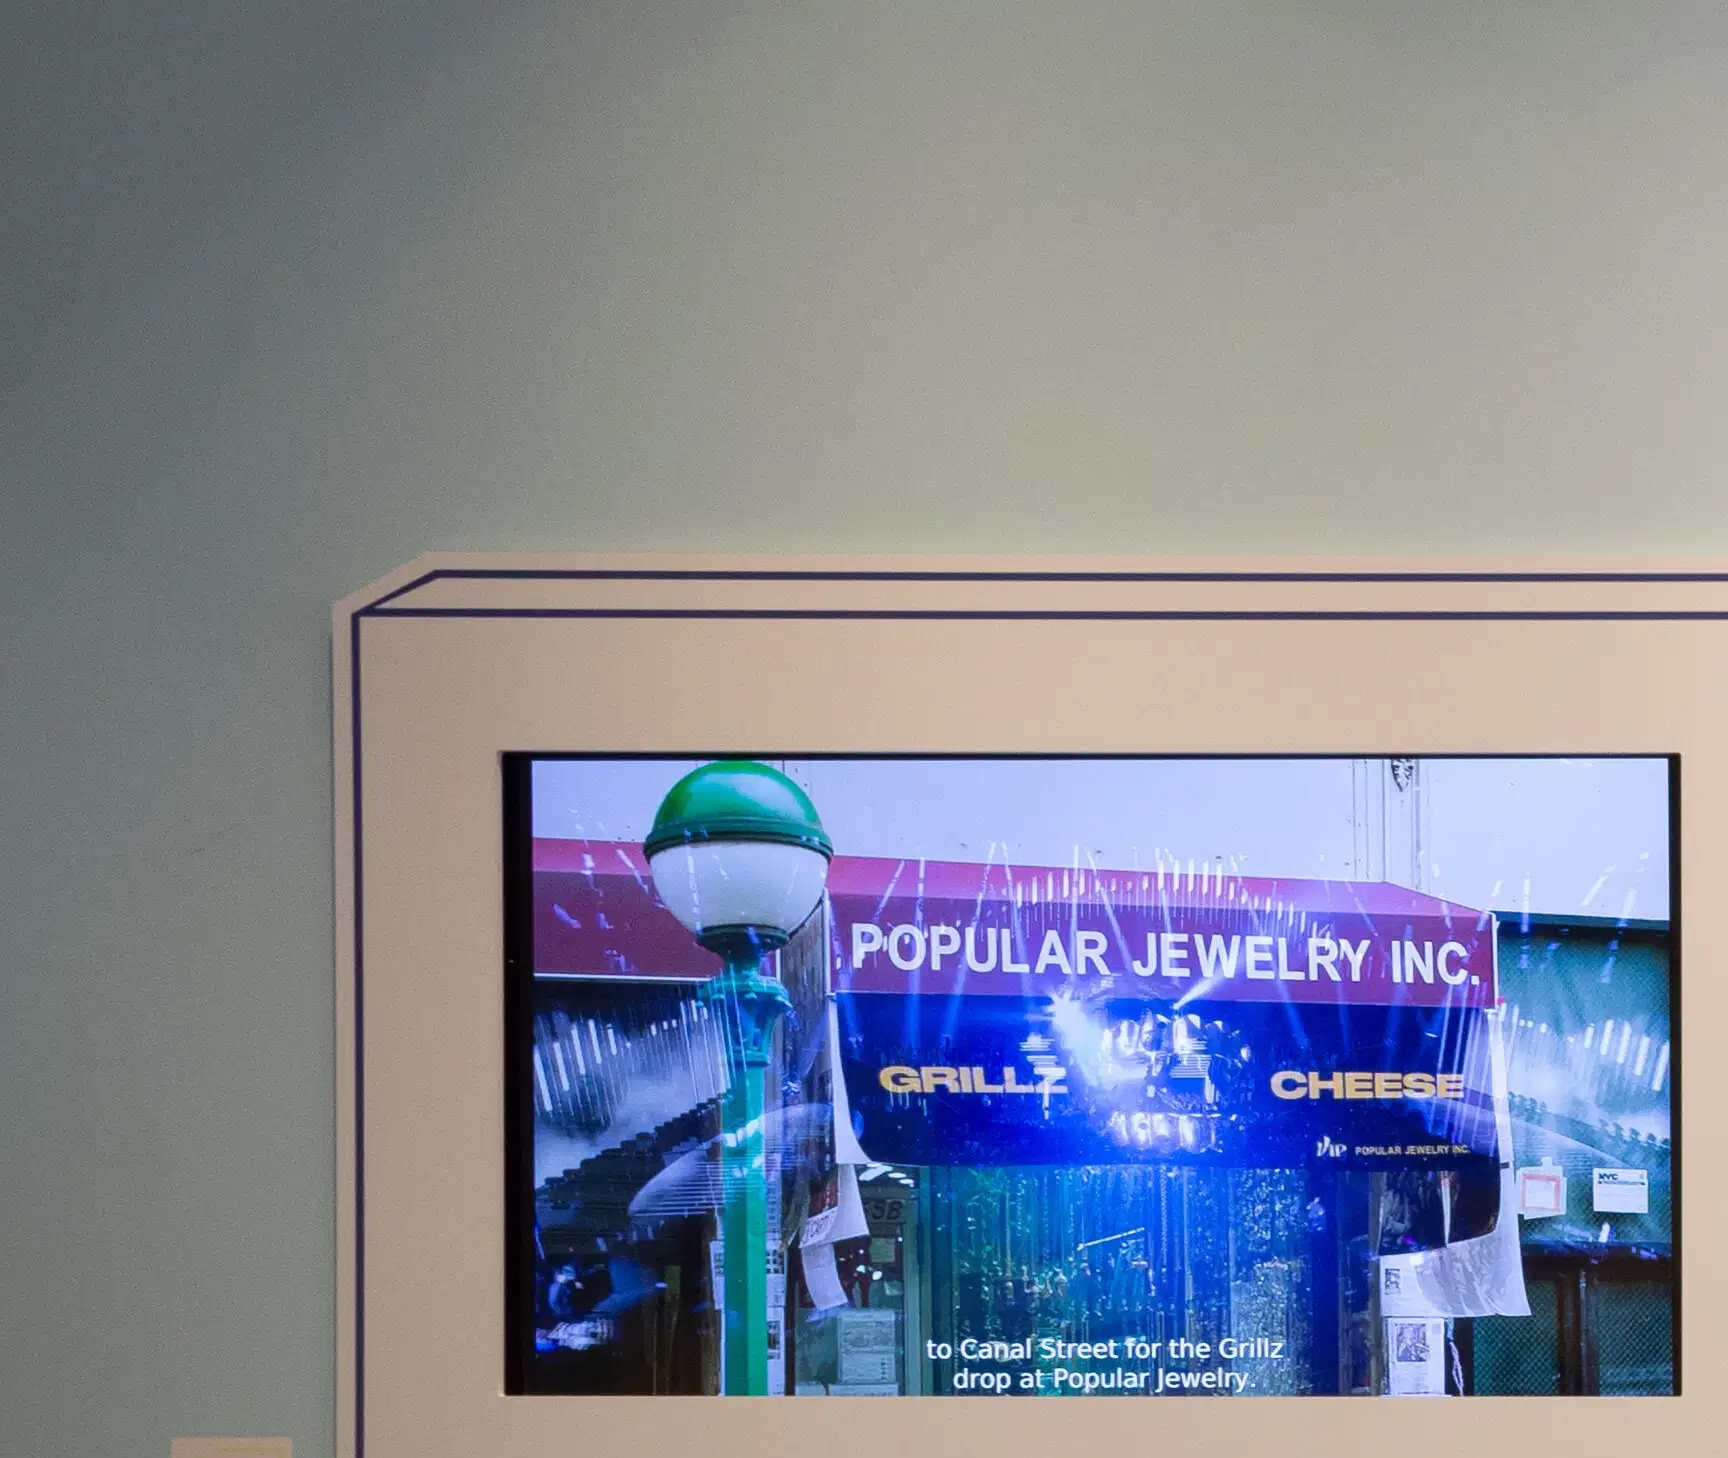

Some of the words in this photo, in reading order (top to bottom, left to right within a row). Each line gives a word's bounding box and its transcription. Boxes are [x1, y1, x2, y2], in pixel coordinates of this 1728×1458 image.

[851, 922, 1109, 976] POPULAR
[1133, 932, 1372, 984] JEWELRY
[1392, 941, 1481, 986] INC.
[878, 1065, 1069, 1094] GRILLZ
[1270, 1070, 1465, 1100] CHEESE
[1355, 1146, 1402, 1157] POPULAR
[1405, 1145, 1450, 1156] JEWELRY
[926, 1340, 952, 1360] to
[960, 1337, 1032, 1360] Canal
[1040, 1337, 1118, 1360] Street
[1125, 1337, 1162, 1360] for
[1169, 1337, 1211, 1360] the
[1218, 1337, 1284, 1360] Grillz
[952, 1367, 1011, 1395] drop
[1019, 1370, 1045, 1390] at
[1054, 1367, 1149, 1395] Popular
[1156, 1367, 1256, 1395] Jewelry.
